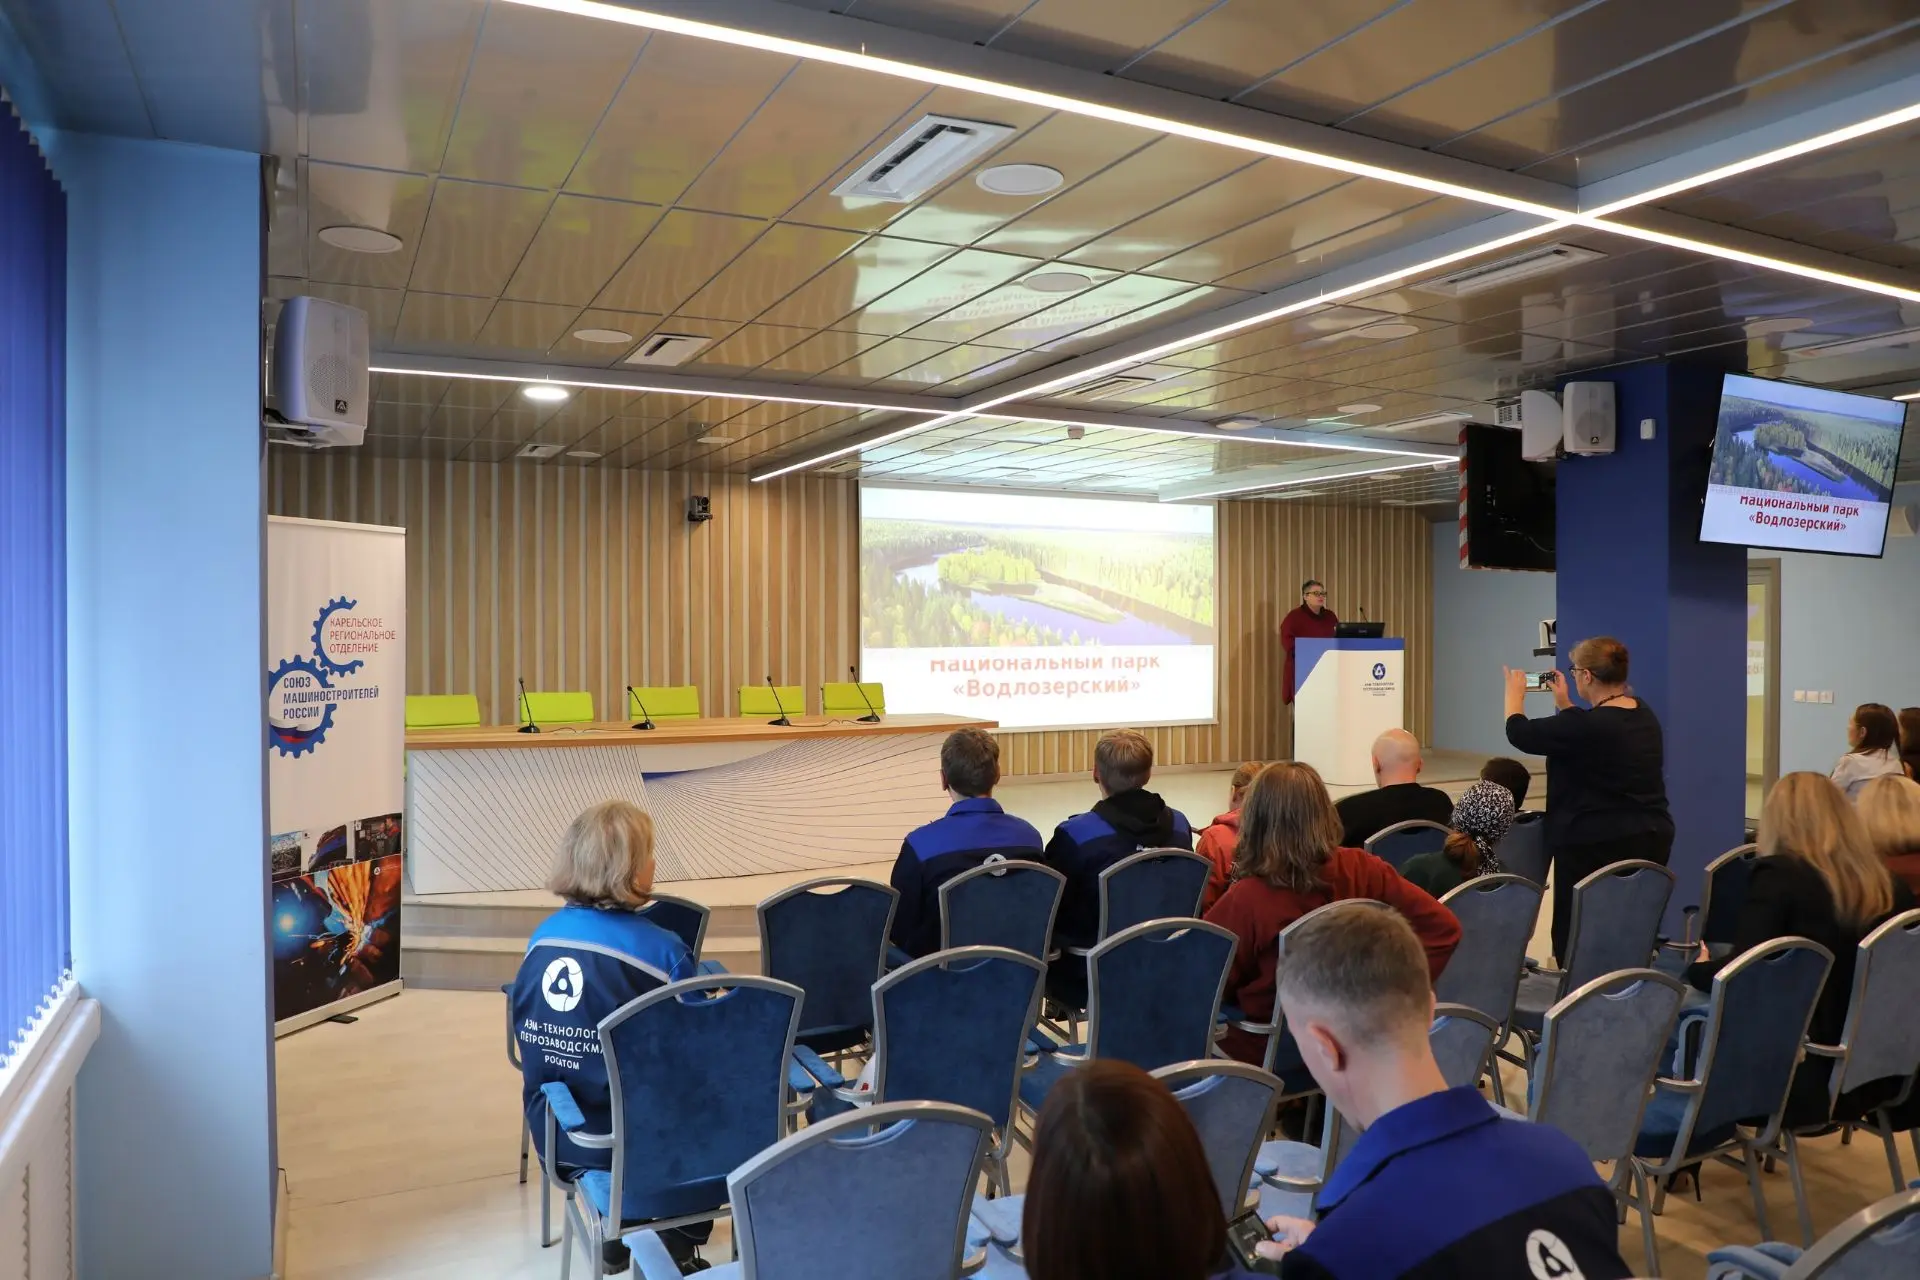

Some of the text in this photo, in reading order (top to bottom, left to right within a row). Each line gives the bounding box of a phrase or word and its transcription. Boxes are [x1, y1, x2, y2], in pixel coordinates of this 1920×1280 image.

[1832, 505, 1860, 518] парк
[1749, 511, 1847, 532] «Водлозерский»
[329, 617, 383, 628] КАРЕЛЬСКОЕ
[329, 630, 396, 641] РЕГИОНАЛЬНОЕ
[329, 643, 379, 655] ОТДЕЛЕНИЕ
[1111, 655, 1160, 672] парк
[283, 676, 311, 689] СОЮЗ
[953, 676, 1141, 699] «Водлозерский»
[283, 687, 379, 704] МАШИНОСТРОИТЕЛЕЙ
[283, 706, 319, 720] РОССИИ
[520, 1031, 604, 1054] ПЕТРОЗАВОДСКМ
[544, 1055, 580, 1070] РОСАТОМ
